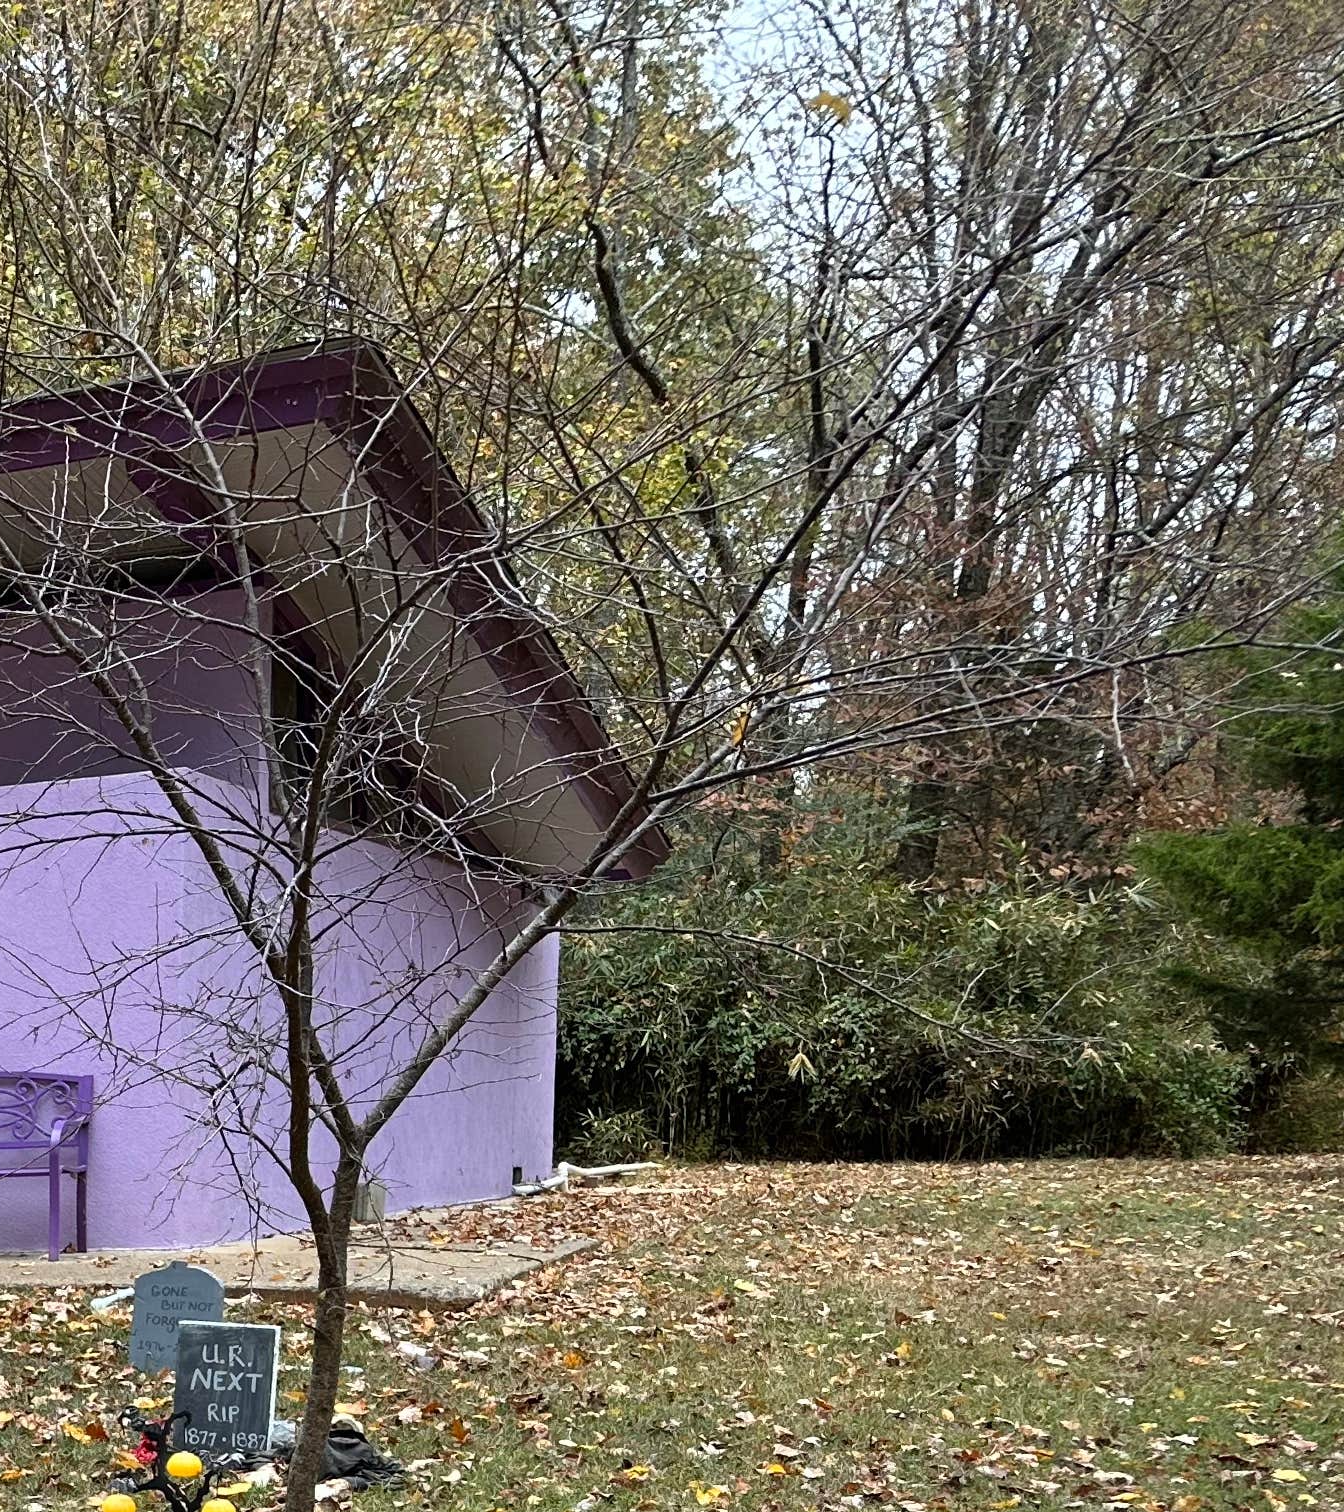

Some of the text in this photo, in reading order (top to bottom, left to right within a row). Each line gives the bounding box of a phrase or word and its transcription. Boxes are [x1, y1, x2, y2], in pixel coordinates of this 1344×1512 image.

[151, 1284, 189, 1297] GONE
[188, 1302, 214, 1312] NOT
[190, 1367, 263, 1393] NEXT
[207, 1402, 240, 1424] RIP
